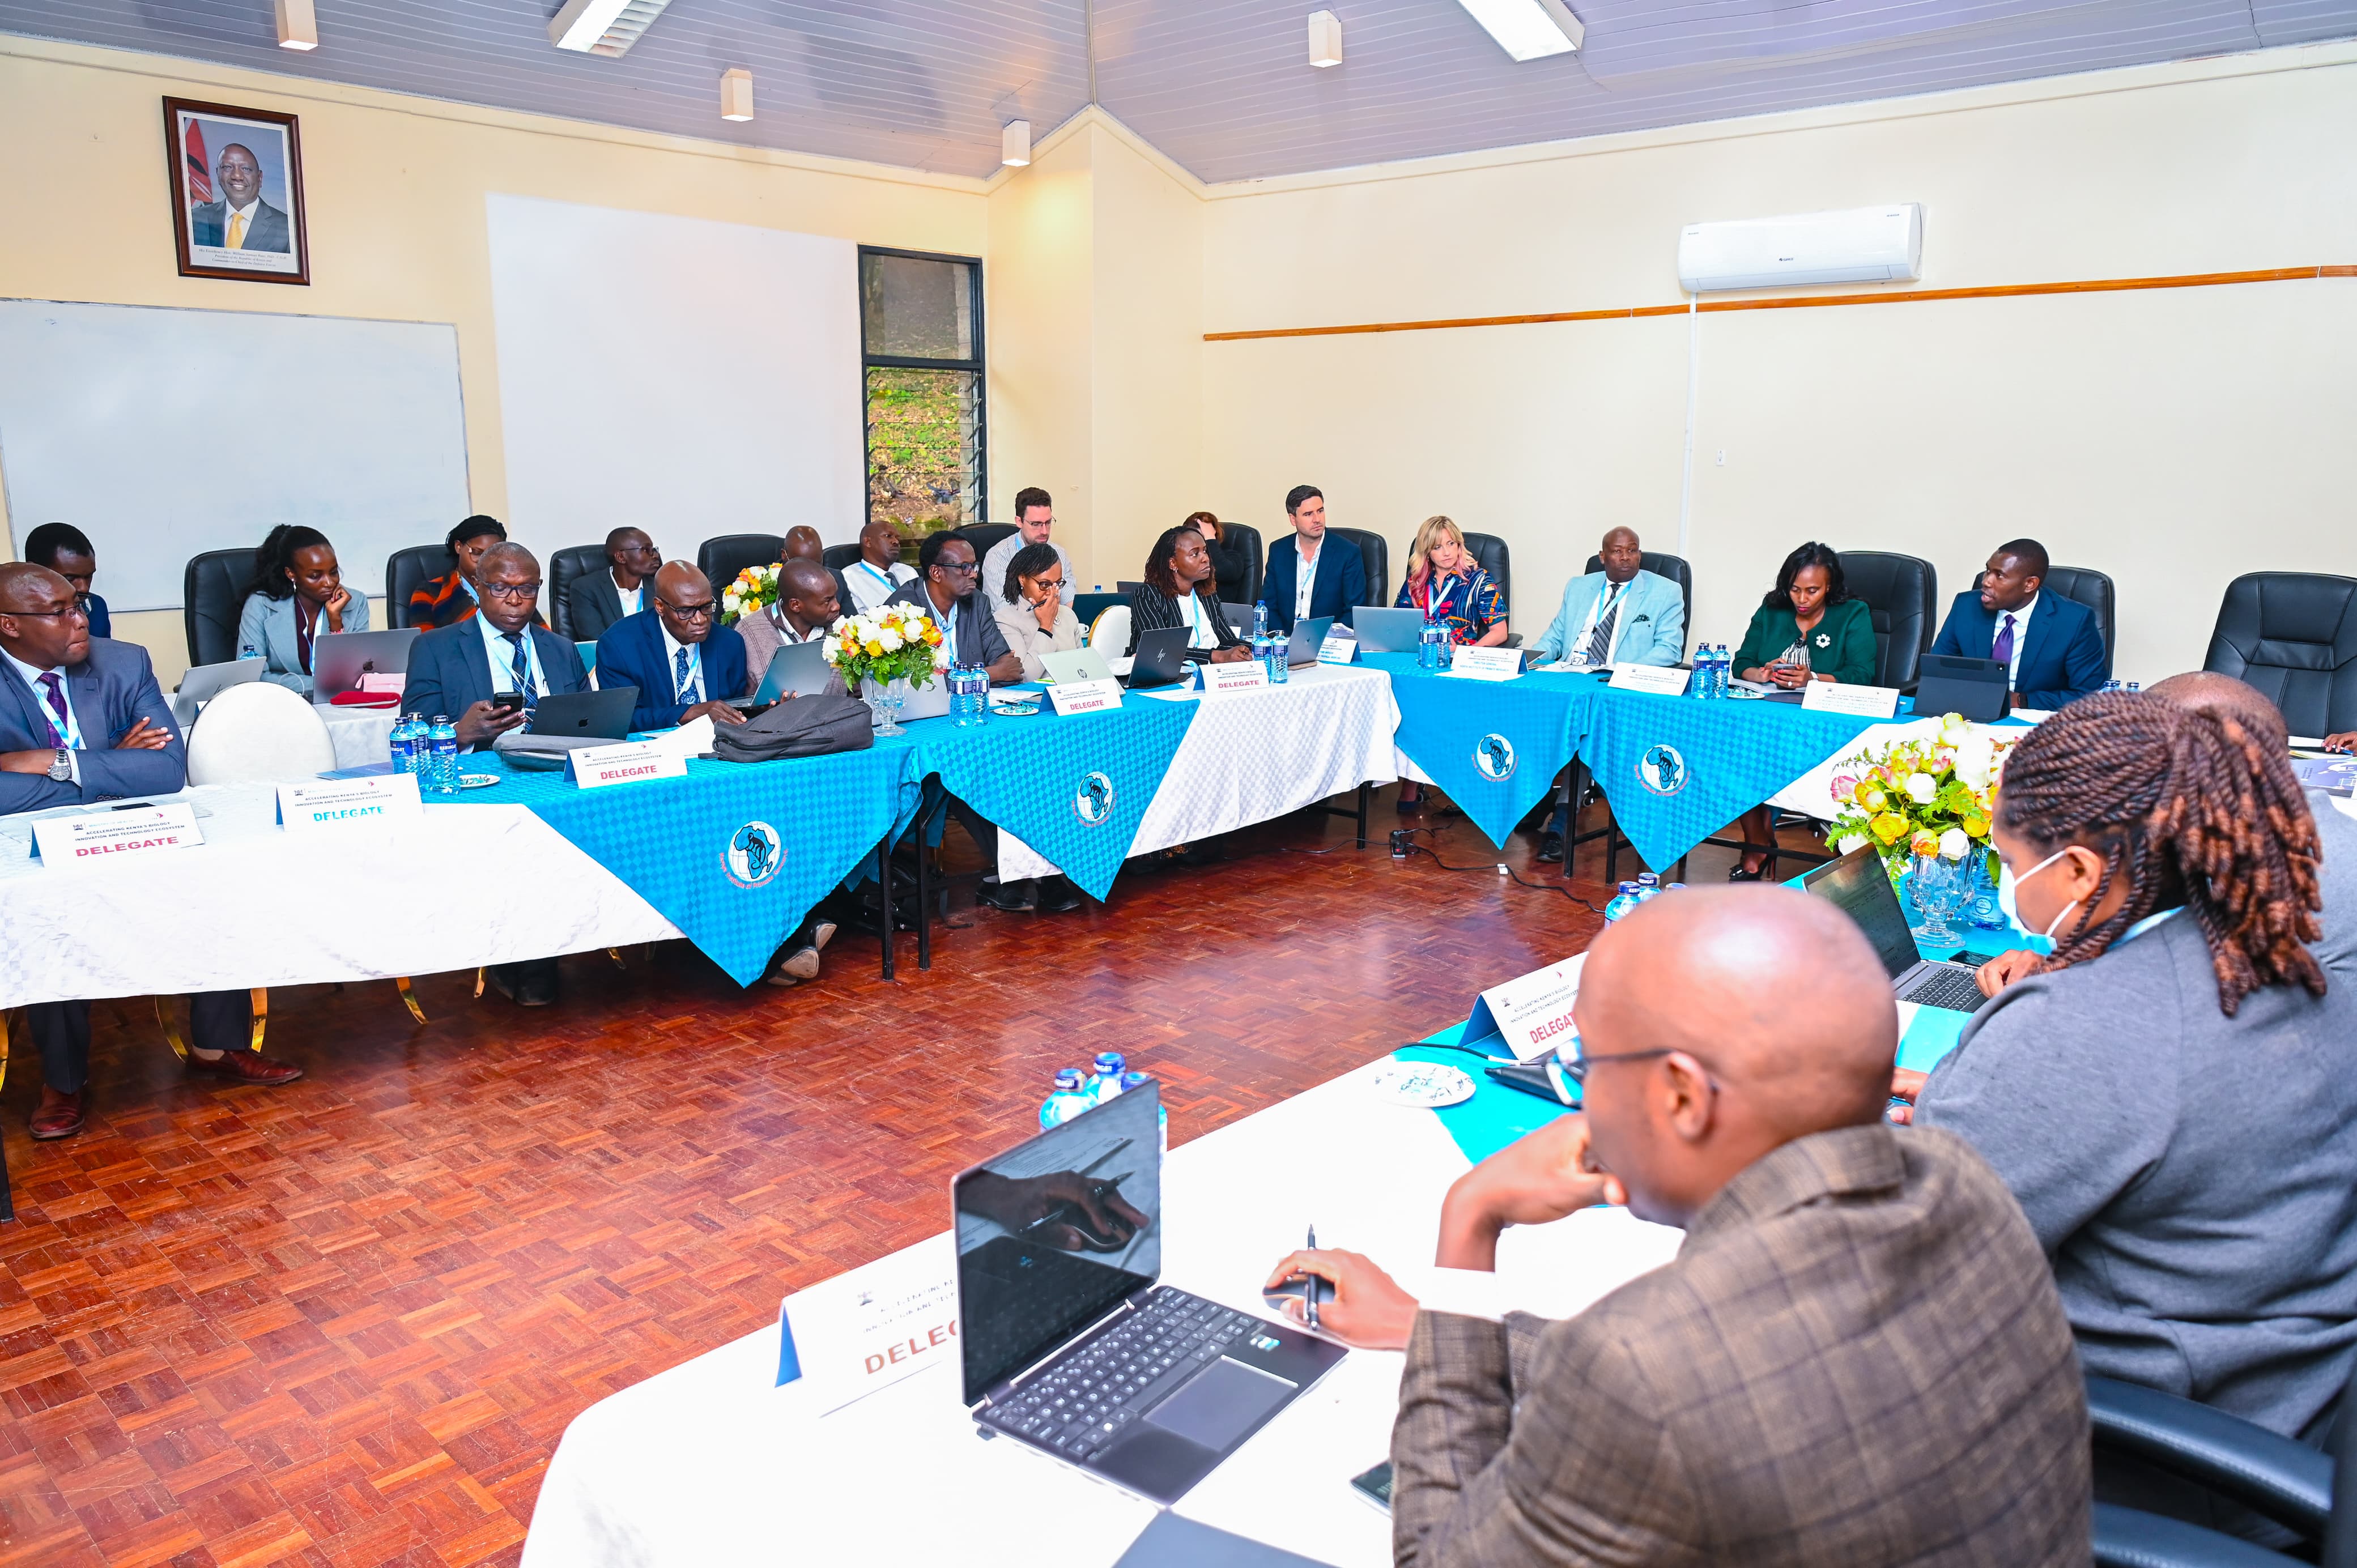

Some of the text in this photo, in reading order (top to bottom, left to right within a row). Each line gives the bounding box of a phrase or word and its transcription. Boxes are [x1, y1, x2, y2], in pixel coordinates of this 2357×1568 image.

[1218, 680, 1260, 688] DELEGATE
[1070, 700, 1104, 710] DELEGATE
[600, 765, 657, 779] DELEGATE
[313, 806, 385, 821] DELEGATE
[75, 836, 179, 857] DELEGATE
[1529, 1011, 1576, 1043] DELEGAT
